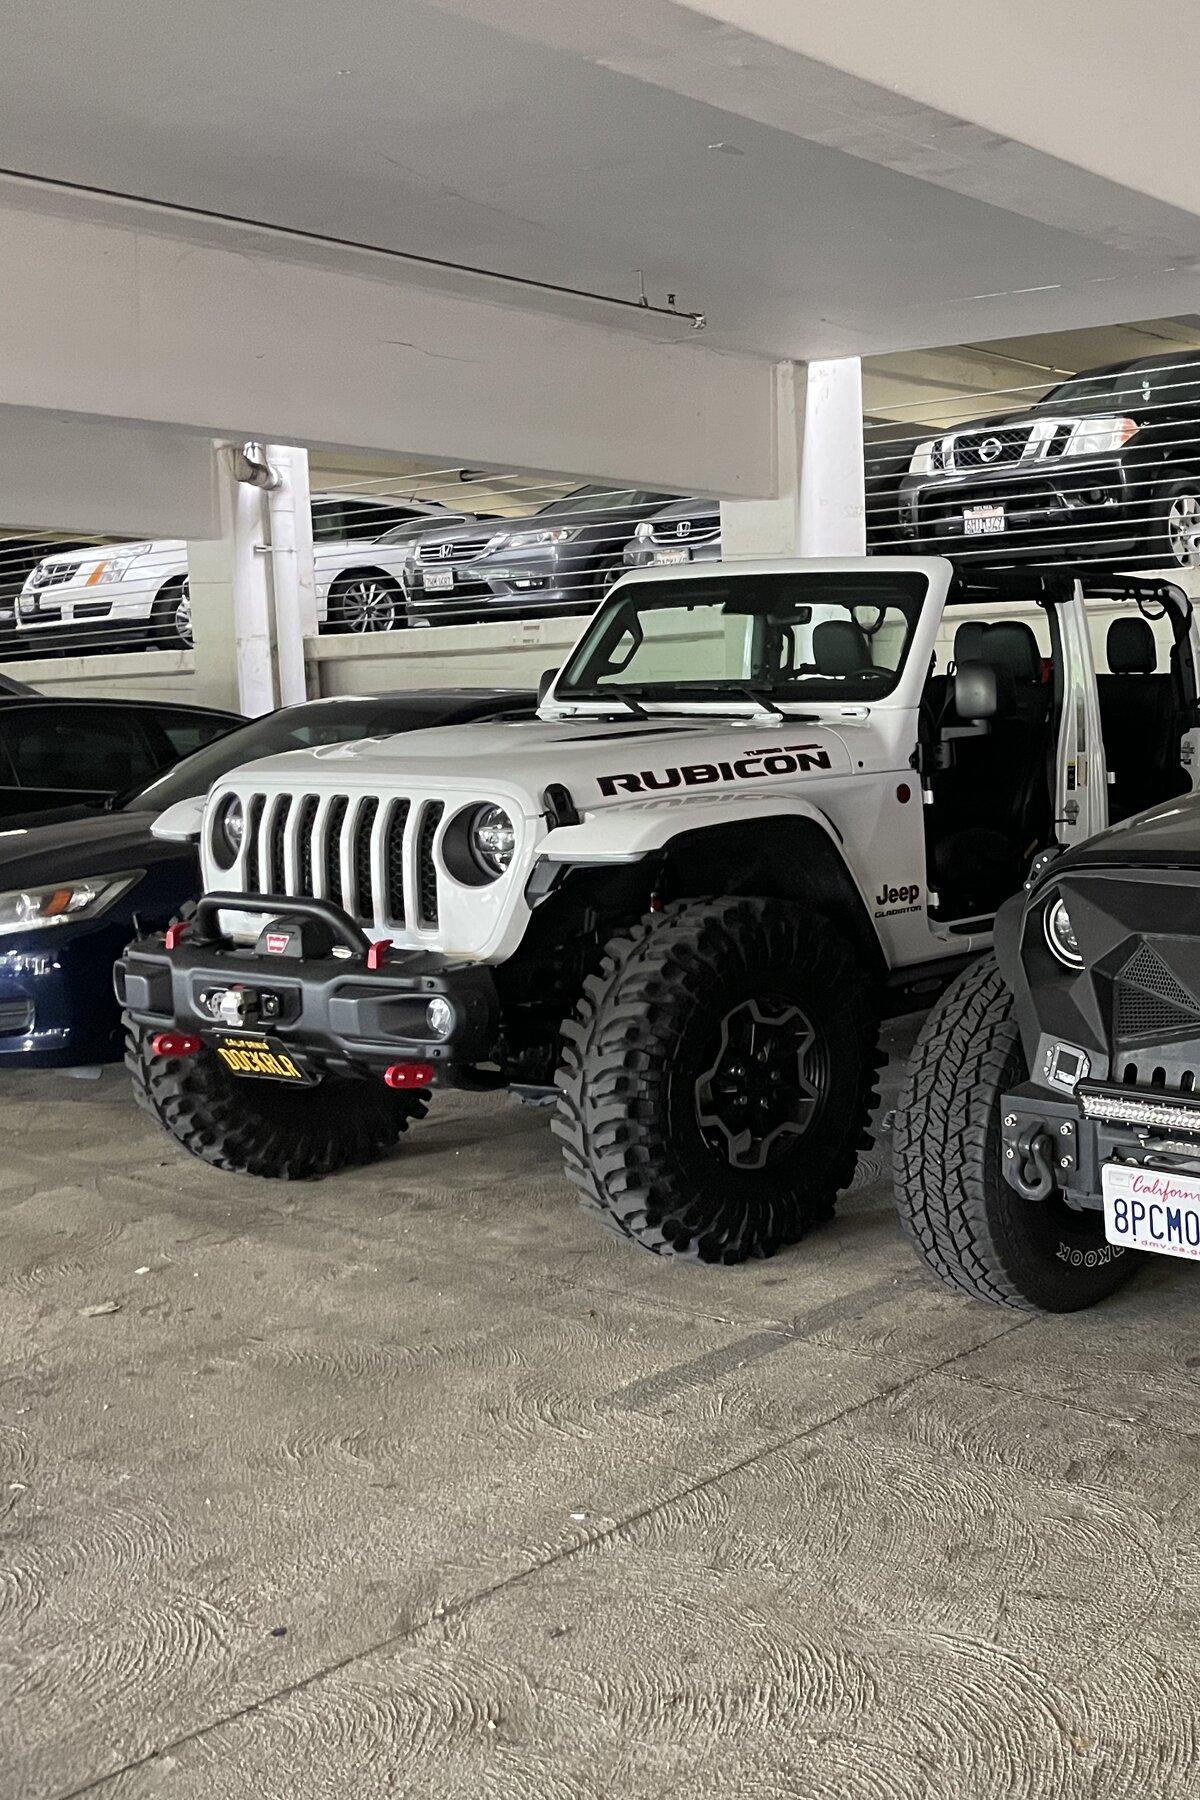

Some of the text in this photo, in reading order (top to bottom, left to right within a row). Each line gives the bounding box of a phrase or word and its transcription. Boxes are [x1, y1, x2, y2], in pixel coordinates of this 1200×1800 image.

[596, 750, 832, 797] RUBICON
[876, 884, 920, 905] Jeep
[874, 905, 922, 918] GLADIATOR
[1056, 1241, 1125, 1267] KOOK
